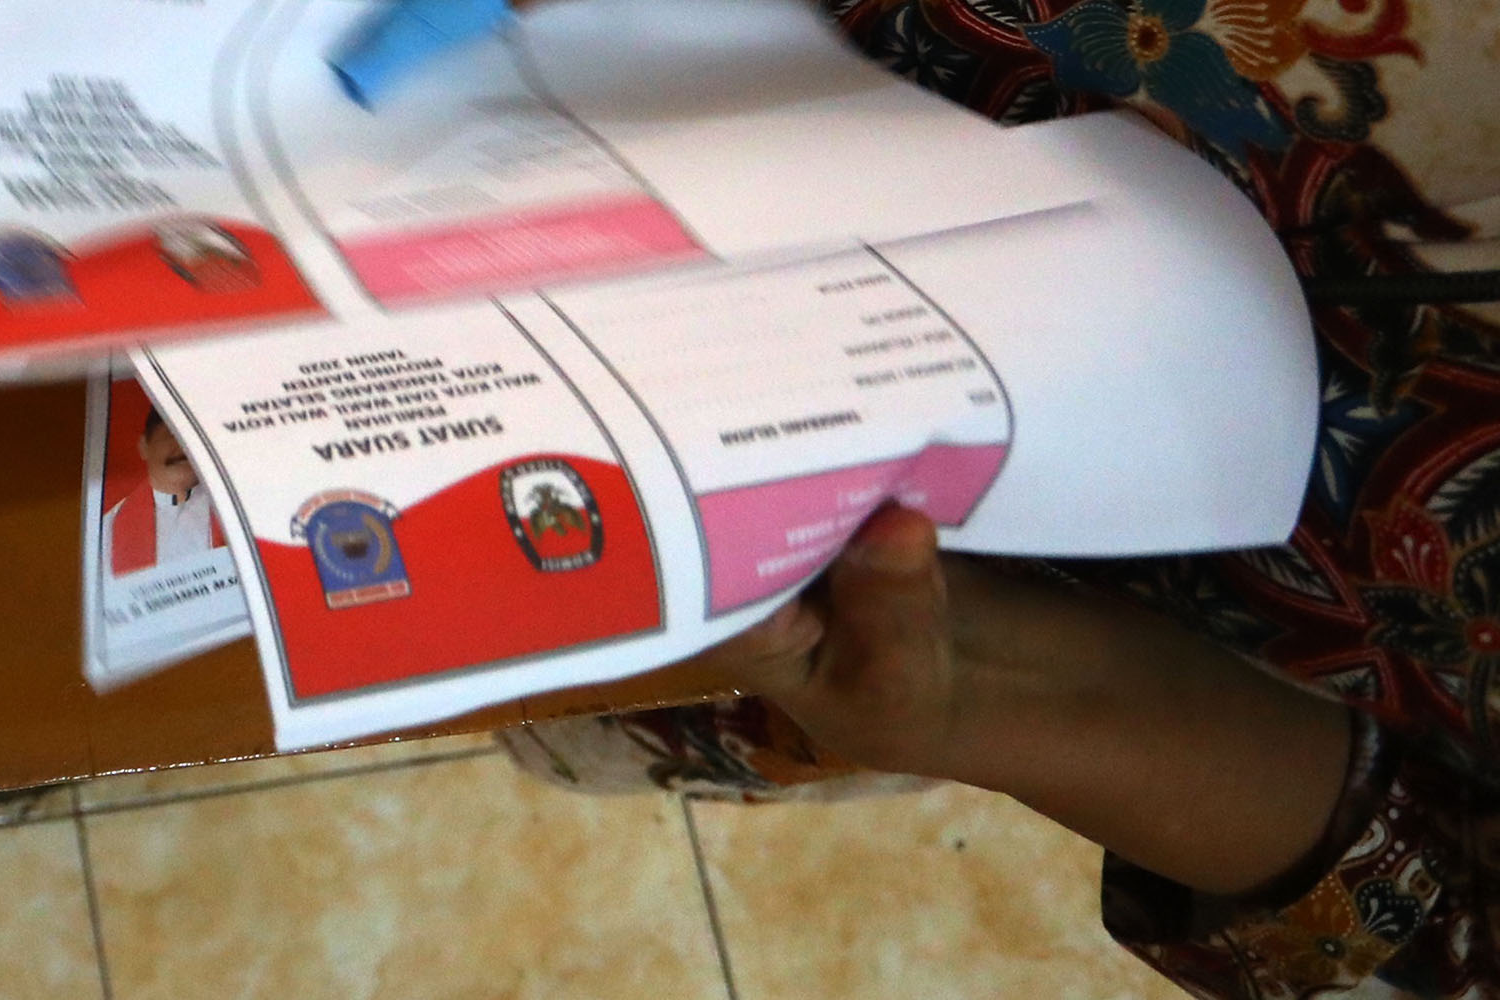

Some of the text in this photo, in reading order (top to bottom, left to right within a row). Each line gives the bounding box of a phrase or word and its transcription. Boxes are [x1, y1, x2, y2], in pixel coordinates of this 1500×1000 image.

[344, 405, 446, 431] PEMILIHAN
[312, 414, 504, 463] SURAT SUARA
